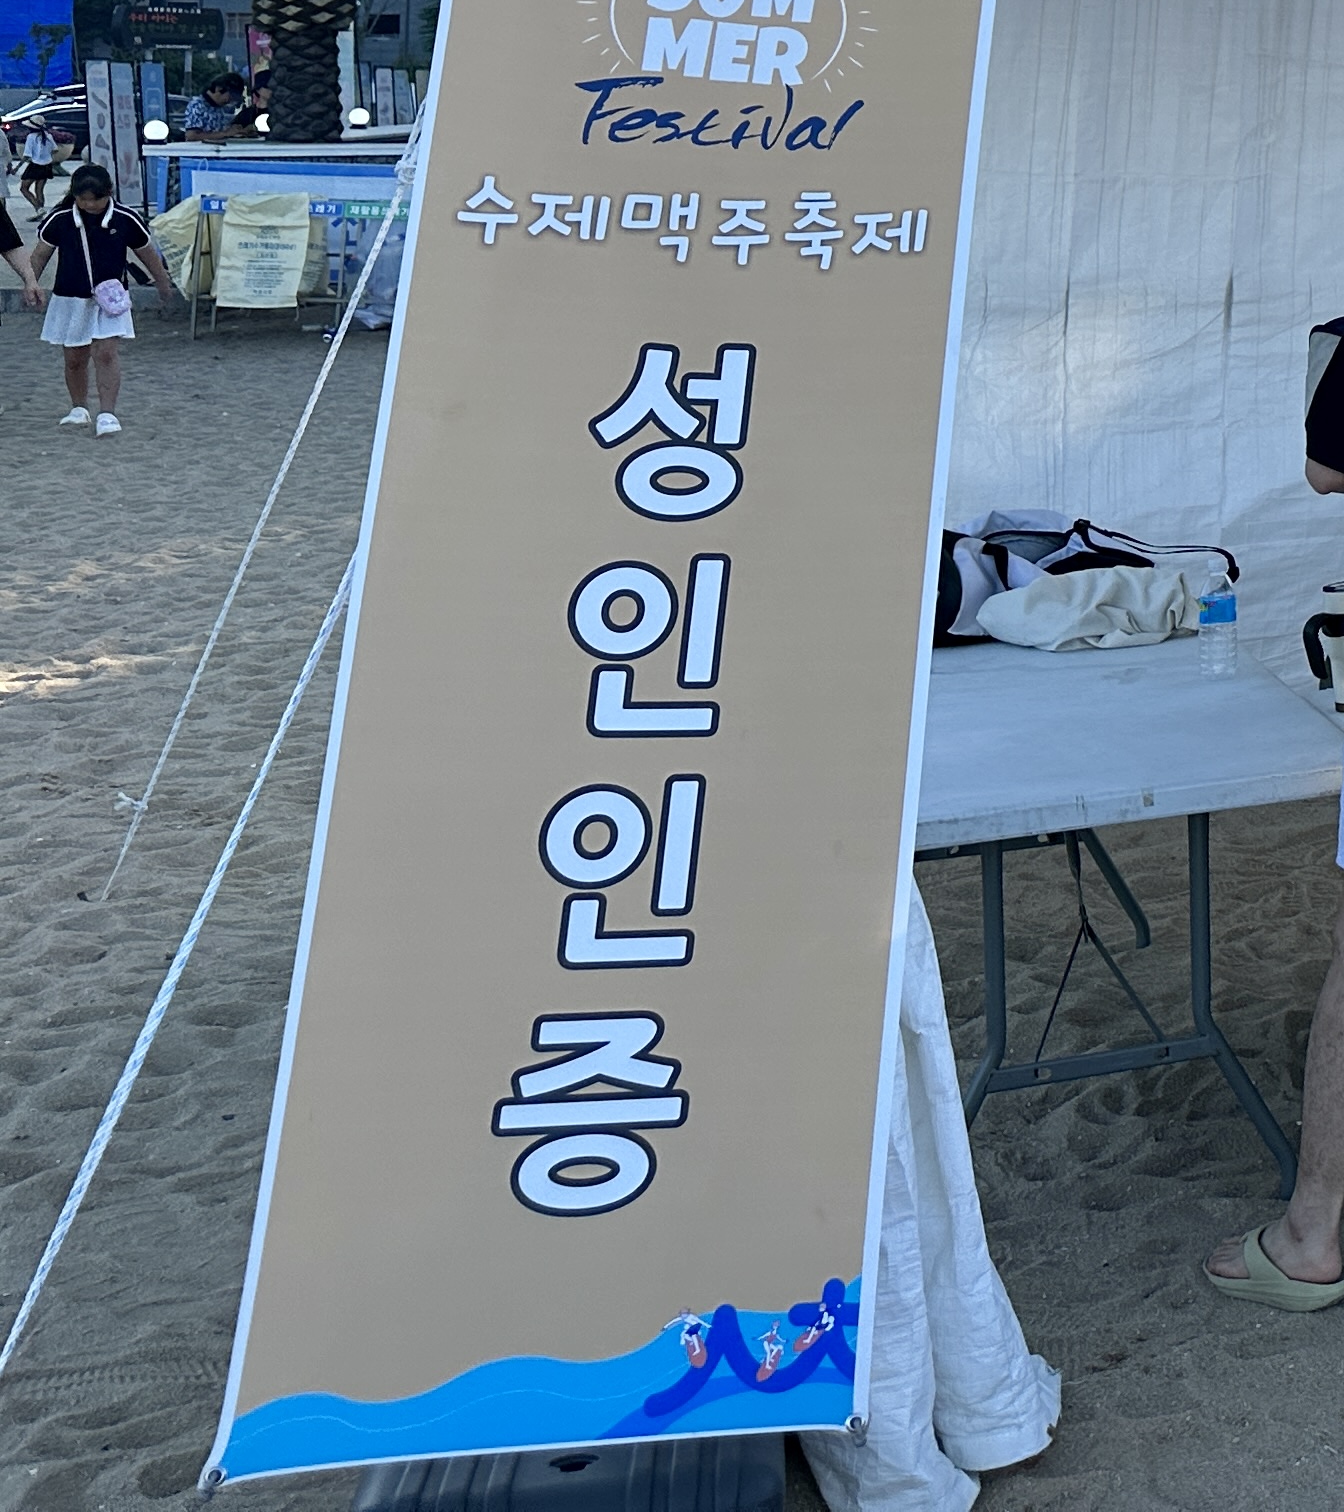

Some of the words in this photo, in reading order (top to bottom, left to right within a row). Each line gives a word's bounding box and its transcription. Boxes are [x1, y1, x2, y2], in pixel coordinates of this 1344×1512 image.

[641, 16, 808, 86] MER
[575, 76, 865, 152] Festival
[457, 175, 928, 270] 수제맥주축제
[490, 341, 757, 1218] 성인인증
